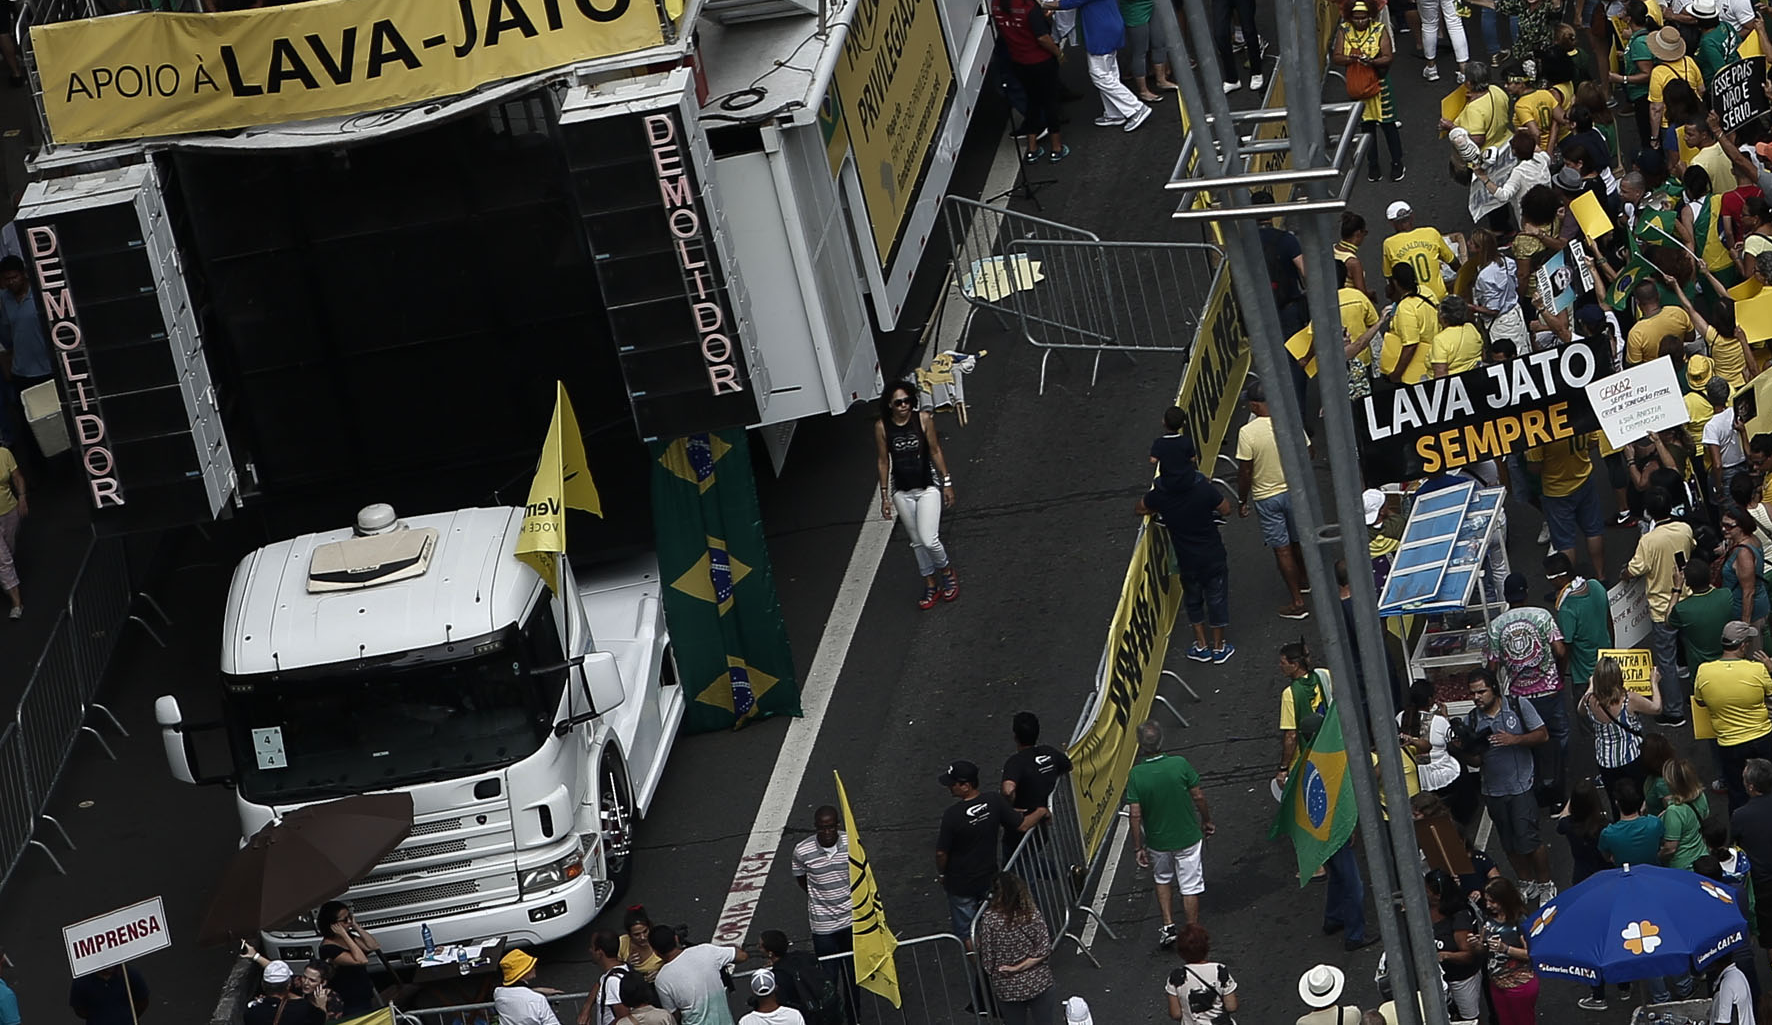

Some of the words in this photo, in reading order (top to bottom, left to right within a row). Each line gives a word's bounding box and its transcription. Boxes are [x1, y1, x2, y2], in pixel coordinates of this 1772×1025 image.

[65, 62, 181, 103] APOIO
[192, 52, 221, 94] À
[1714, 70, 1732, 97] ESSE
[1731, 59, 1755, 85] PAÍS
[1722, 85, 1741, 112] NÃO
[645, 113, 744, 397] DEMOLIDOR
[1408, 253, 1432, 283] 10
[26, 225, 126, 510] DEMOLIDOR
[1364, 376, 1476, 442] LAVA
[1485, 342, 1597, 410] JATO
[1415, 400, 1575, 474] SEMPRE
[73, 915, 161, 960] IMPRENSA
[1717, 931, 1743, 952] CAIXA
[1568, 965, 1597, 980] CAIXA
